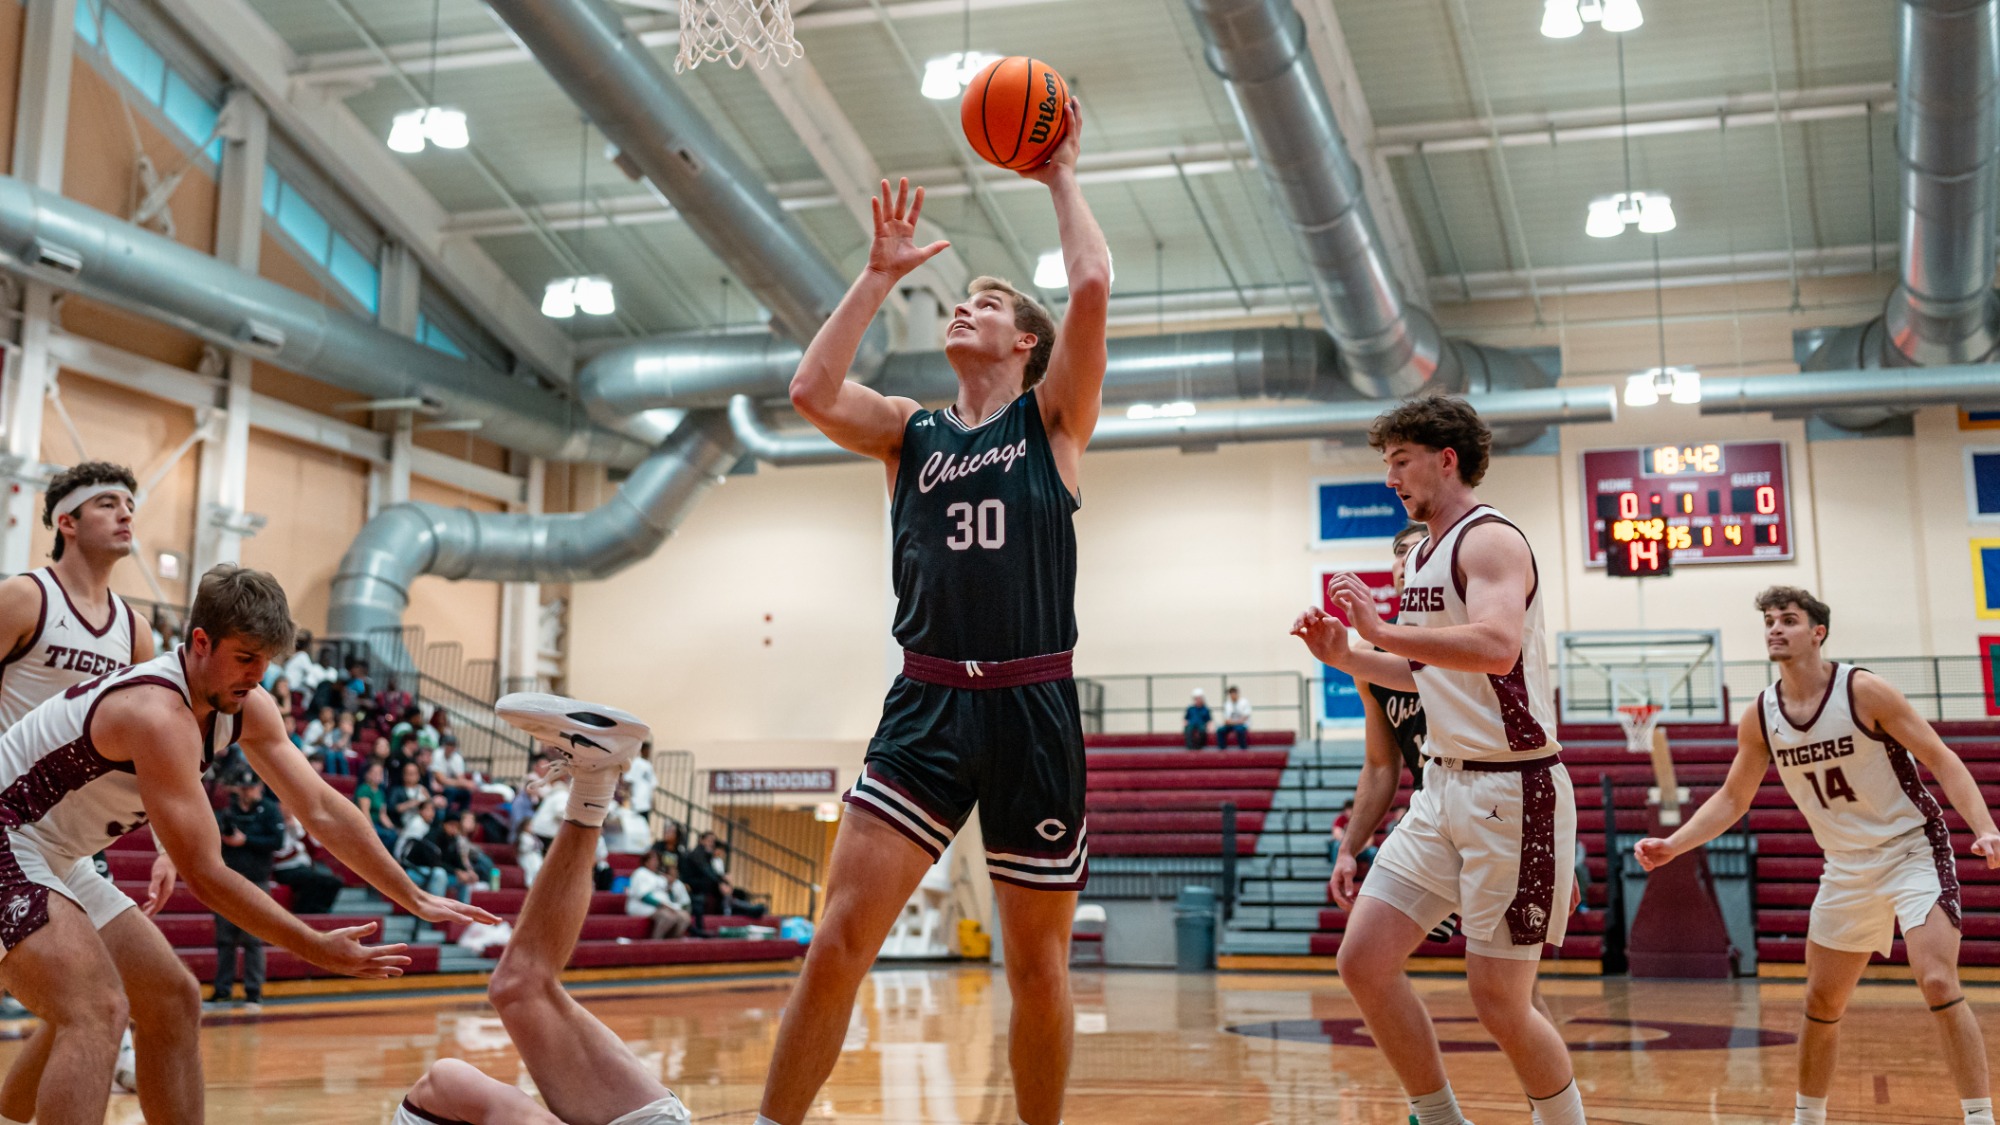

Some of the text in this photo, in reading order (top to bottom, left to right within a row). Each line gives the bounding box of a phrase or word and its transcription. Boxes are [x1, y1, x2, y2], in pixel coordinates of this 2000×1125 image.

[1028, 72, 1057, 144] Wilson
[1653, 445, 1720, 474] 18:42
[1620, 492, 1639, 519] 0
[1756, 486, 1775, 514] 0
[946, 499, 1005, 551] 30
[1724, 525, 1742, 545] 4
[1629, 541, 1659, 570] 14
[1400, 587, 1445, 612] GERS
[44, 645, 128, 676] TIGER
[1386, 696, 1422, 728] Chic
[1777, 735, 1854, 767] TIGERS
[1803, 766, 1858, 810] 14
